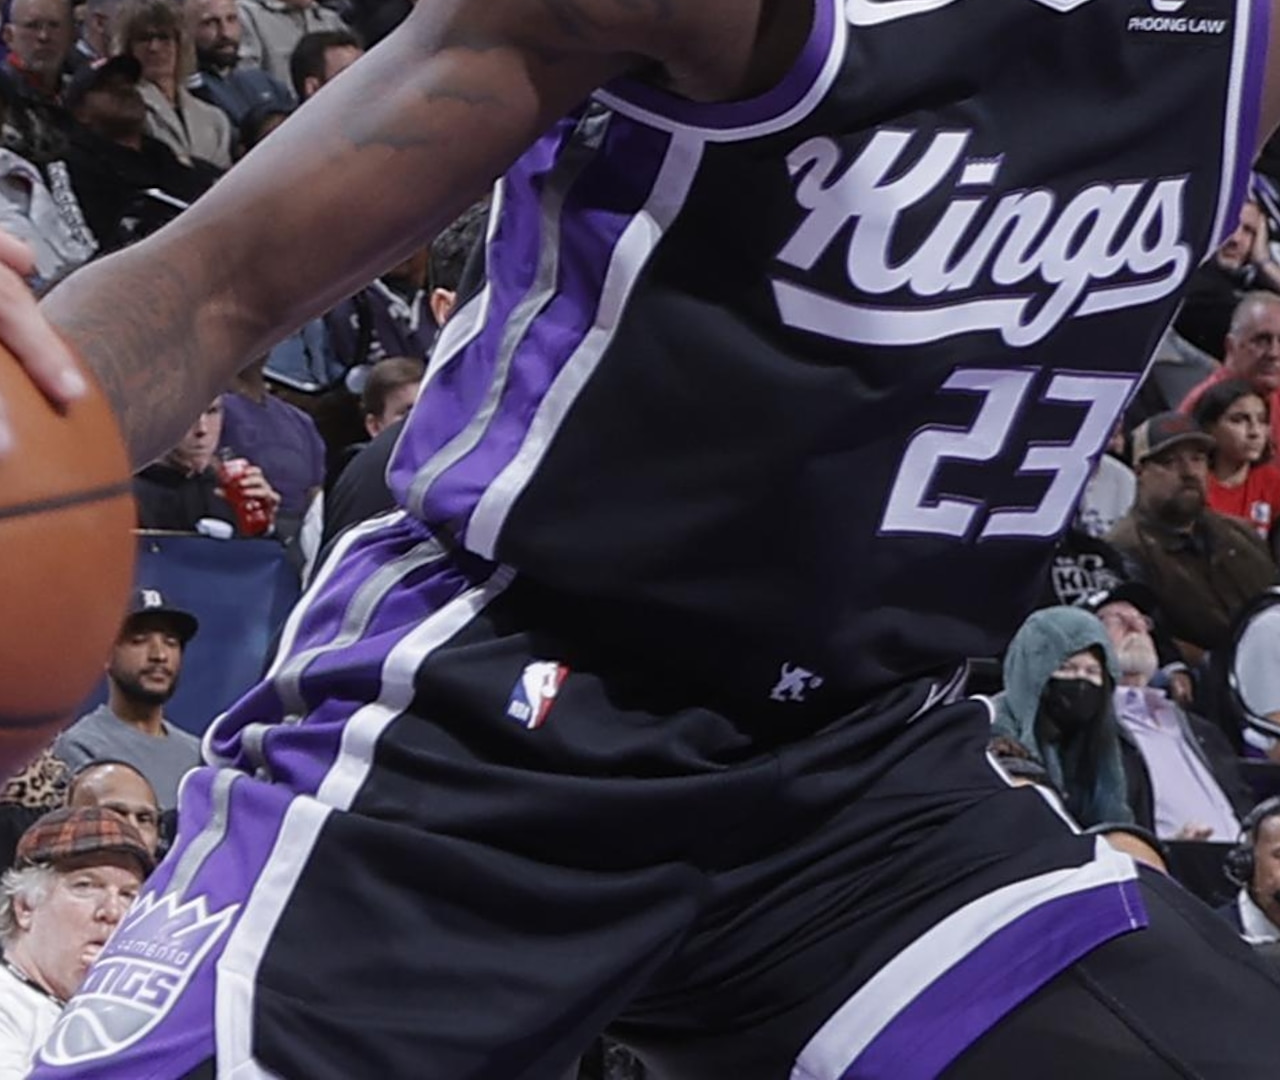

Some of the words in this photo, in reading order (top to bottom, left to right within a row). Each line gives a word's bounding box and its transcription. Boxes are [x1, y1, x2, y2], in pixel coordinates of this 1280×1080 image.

[1127, 16, 1187, 33] PHOONG
[1188, 19, 1226, 34] LAW
[770, 127, 1191, 348] Kings
[876, 366, 1141, 542] 23
